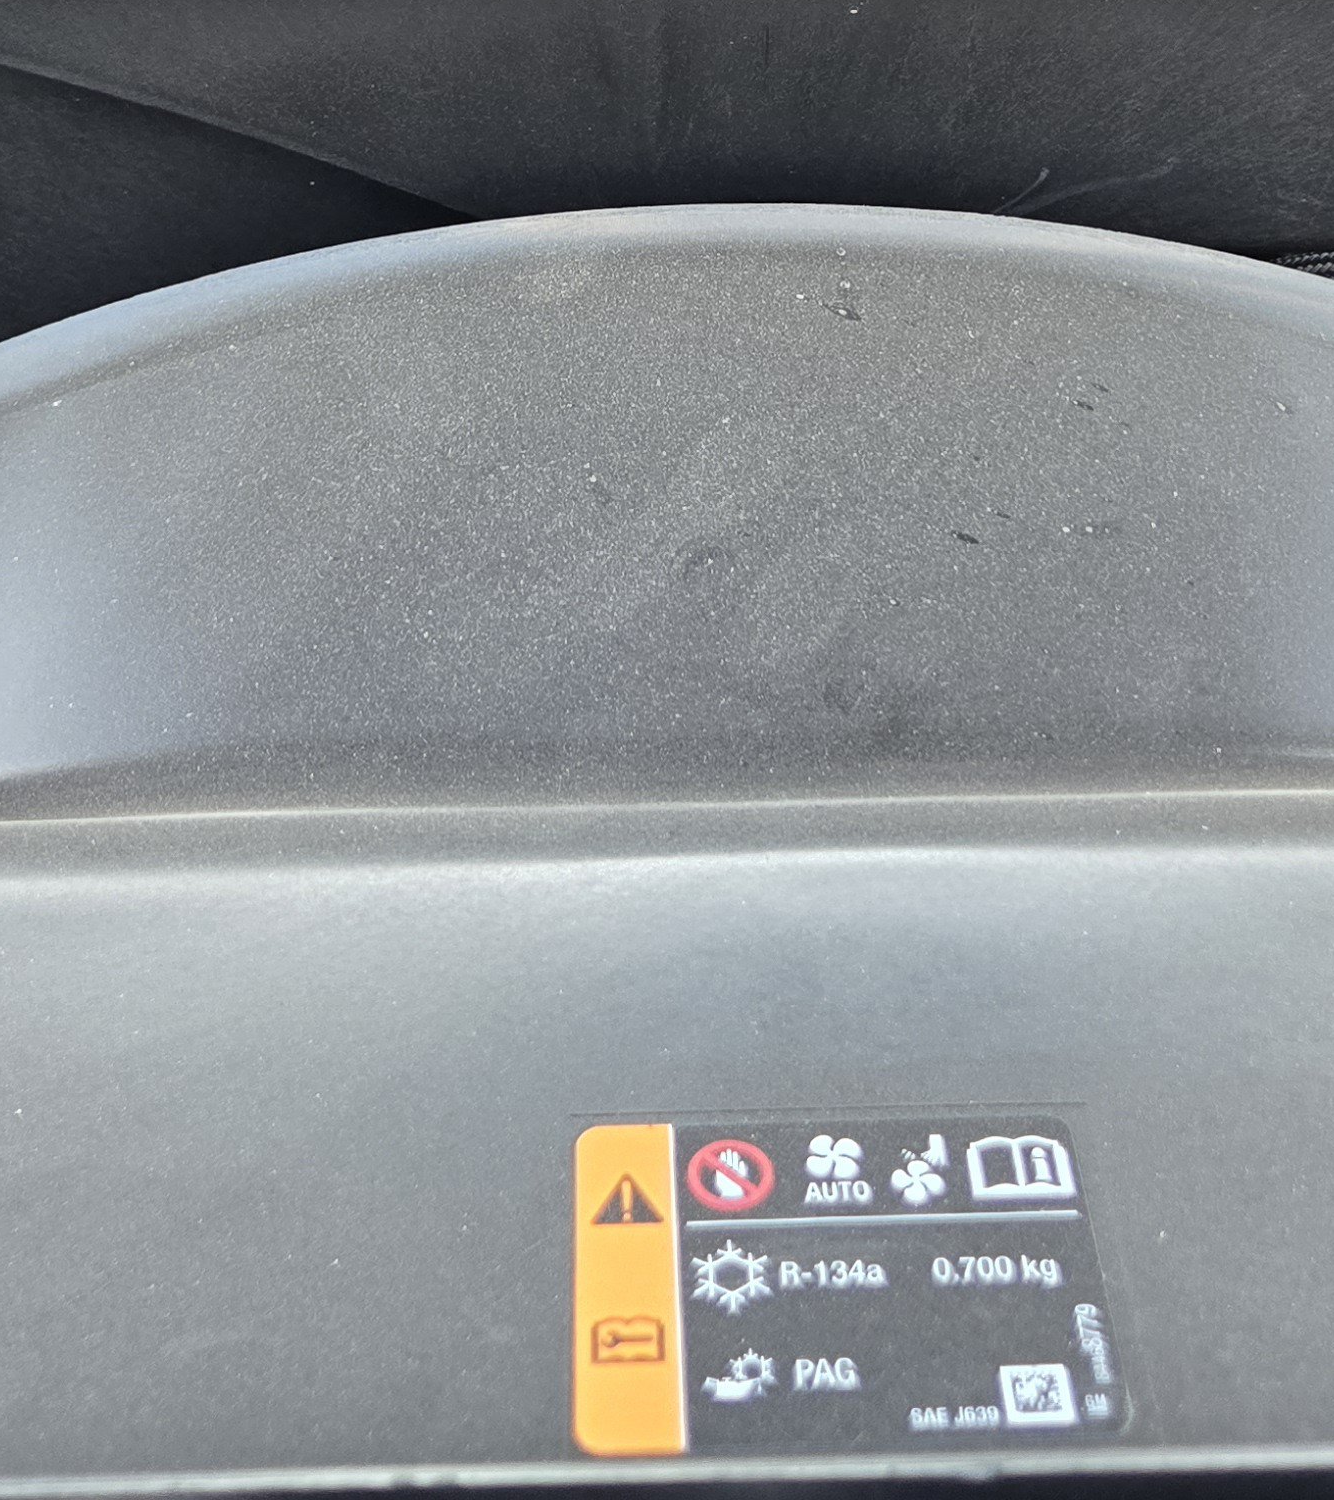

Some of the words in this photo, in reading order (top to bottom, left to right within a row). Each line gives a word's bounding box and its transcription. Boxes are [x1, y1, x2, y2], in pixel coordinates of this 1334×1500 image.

[805, 1180, 872, 1203] AUTO
[779, 1260, 887, 1288] R-134a
[932, 1256, 1013, 1286] 0.700
[1020, 1254, 1063, 1288] kg
[793, 1357, 861, 1391] PAG
[910, 1406, 949, 1430] SAE
[954, 1405, 1000, 1429] J639
